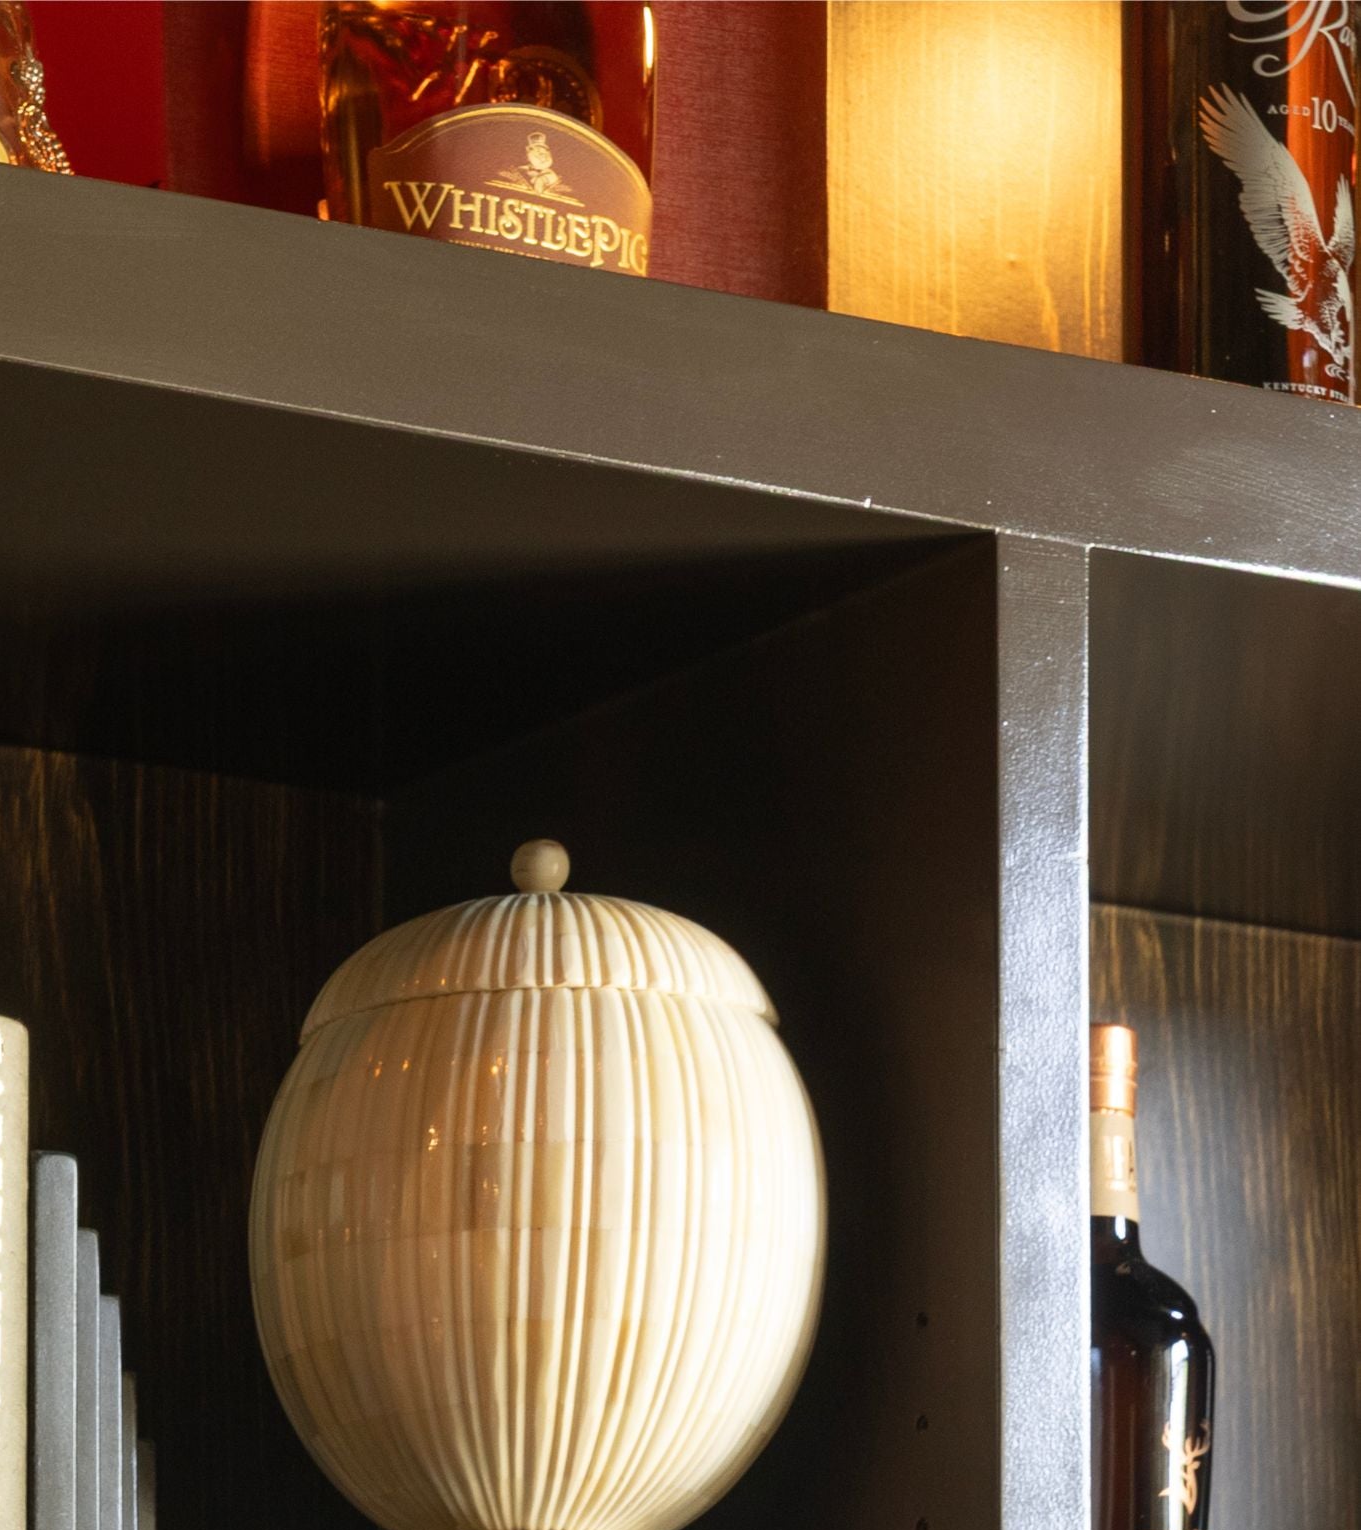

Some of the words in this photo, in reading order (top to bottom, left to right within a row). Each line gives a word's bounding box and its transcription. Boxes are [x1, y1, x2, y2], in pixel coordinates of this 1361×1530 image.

[1268, 105, 1310, 117] AGED
[1311, 96, 1338, 133] 10
[1262, 381, 1328, 397] KENTUCKY
